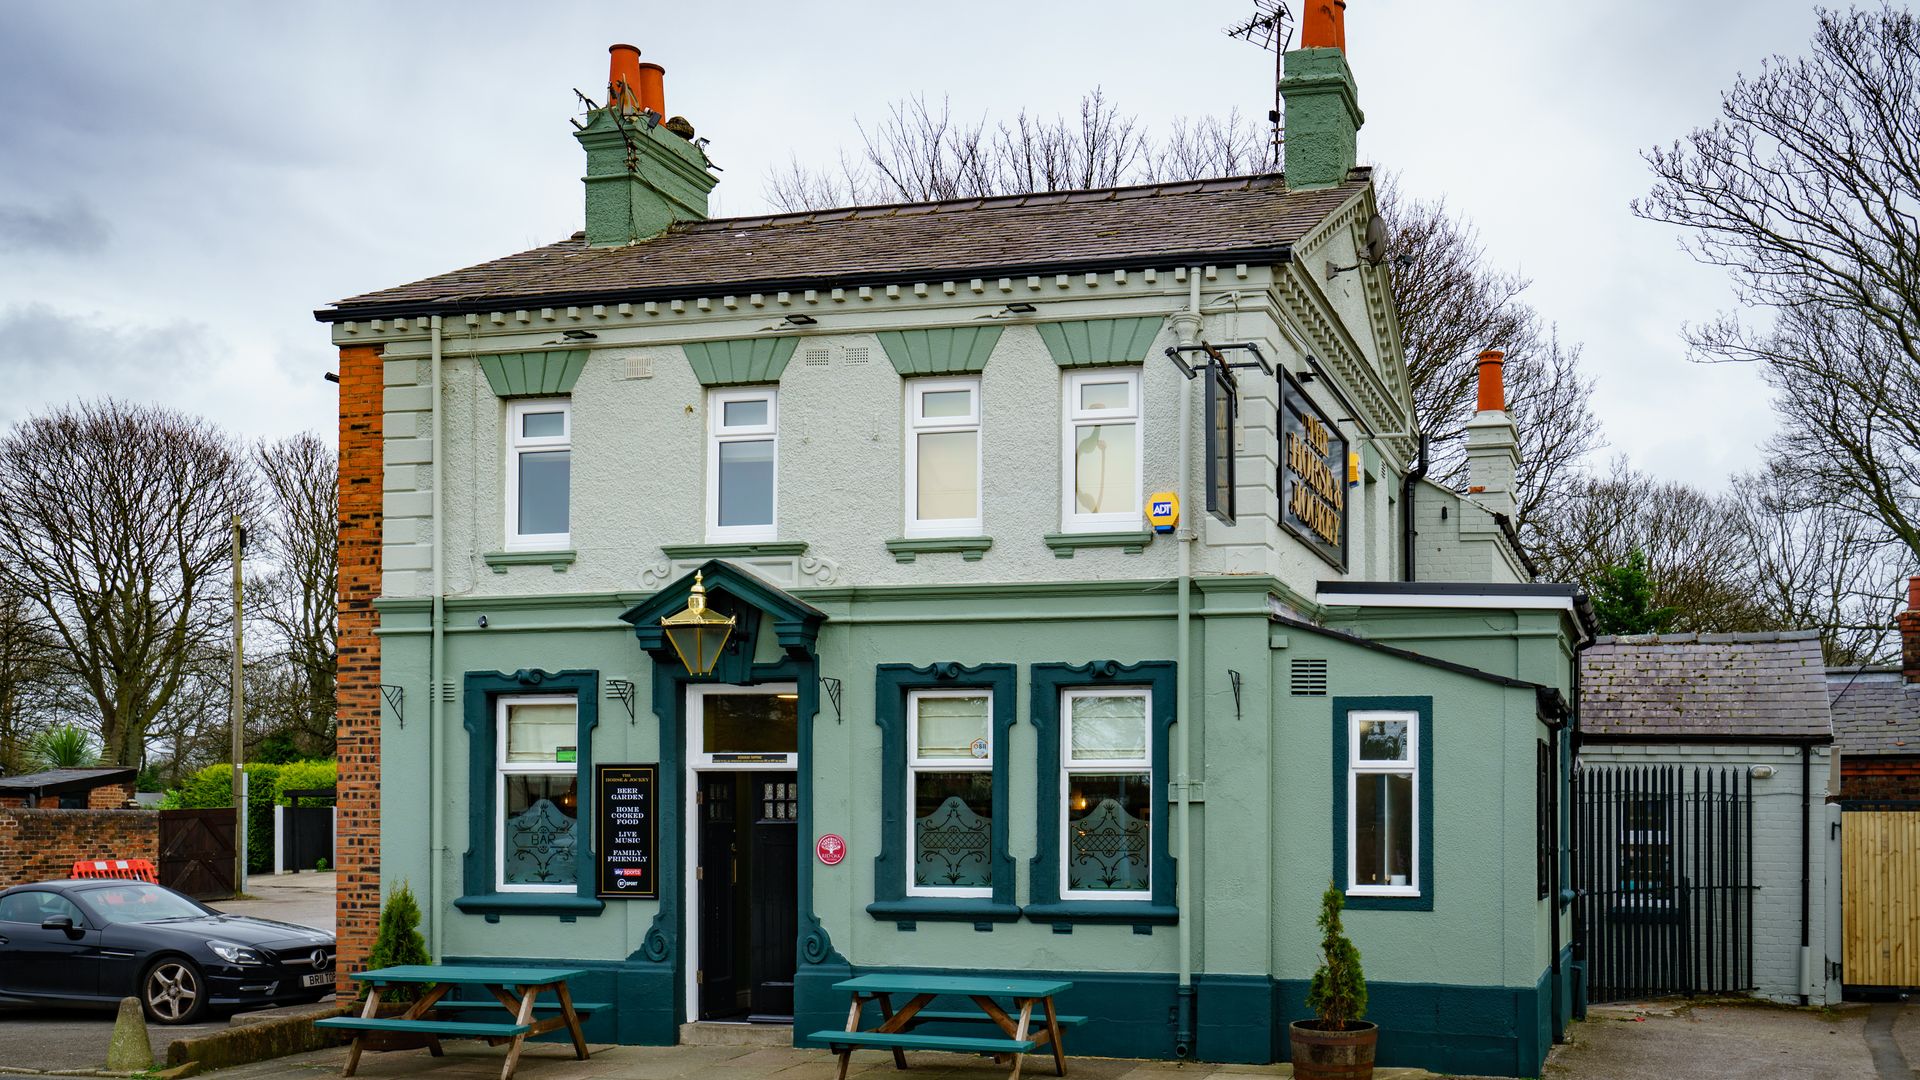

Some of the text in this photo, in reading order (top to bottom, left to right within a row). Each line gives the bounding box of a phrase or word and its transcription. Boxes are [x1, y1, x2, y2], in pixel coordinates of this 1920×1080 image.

[1302, 412, 1329, 458] THE
[1288, 431, 1343, 512] HORSE &
[1153, 504, 1172, 515] ADT
[1290, 480, 1341, 547] JOCKEY
[531, 834, 556, 845] BAR
